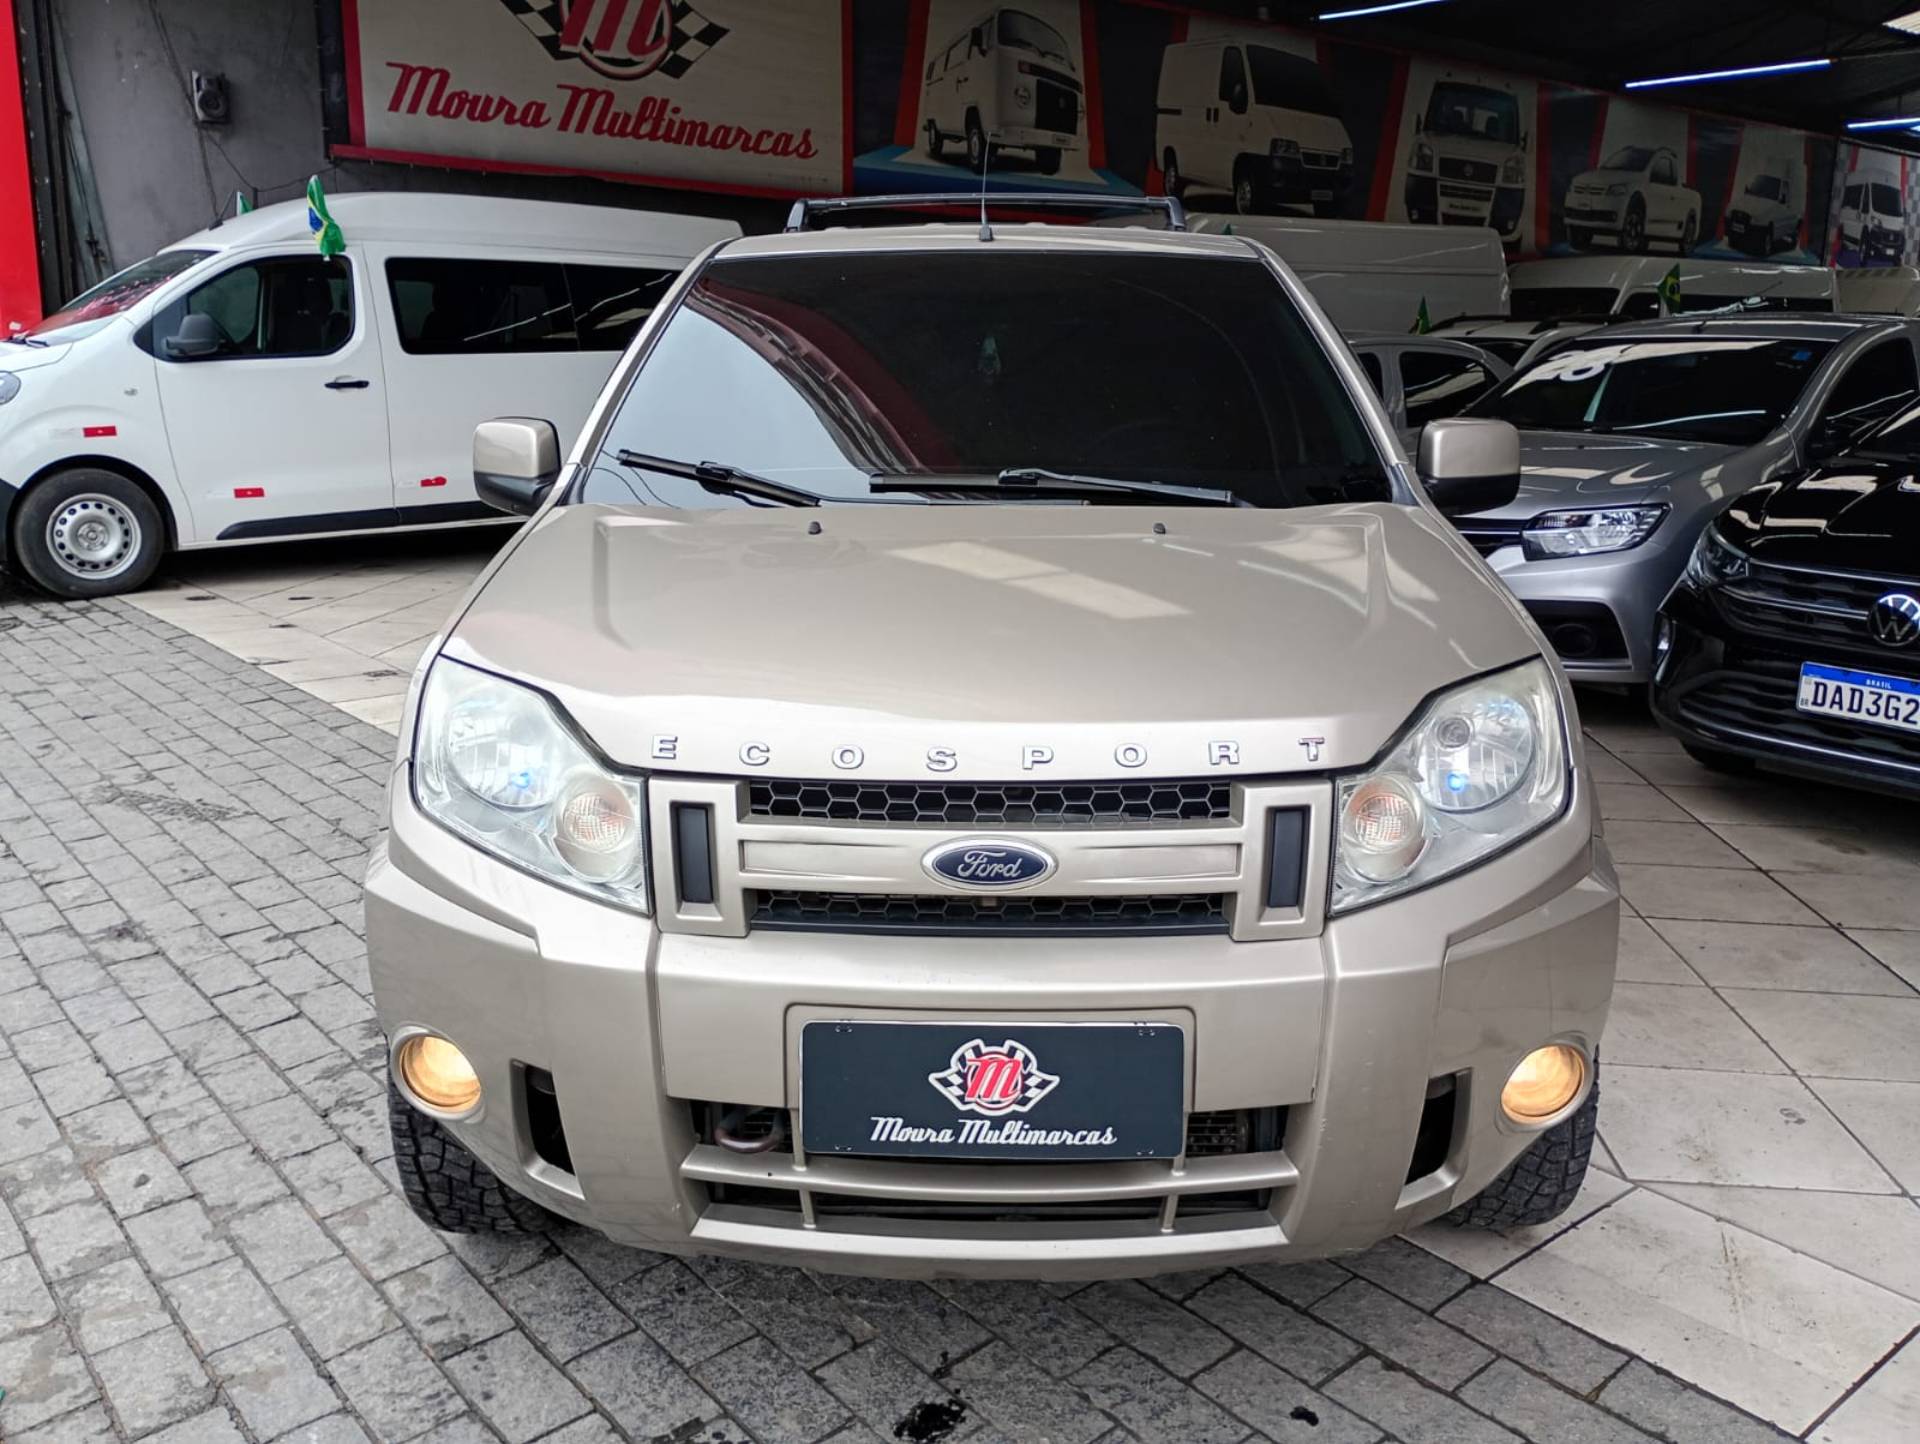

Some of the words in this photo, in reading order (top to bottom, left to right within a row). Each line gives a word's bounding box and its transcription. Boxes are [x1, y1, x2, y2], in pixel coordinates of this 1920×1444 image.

[386, 61, 552, 129] Moura
[556, 84, 819, 160] Multimarcas
[651, 734, 1325, 772] ECOSPORT
[957, 850, 1023, 877] Ford
[870, 1116, 955, 1144] Moura
[958, 1119, 1118, 1145] Multimarcas
